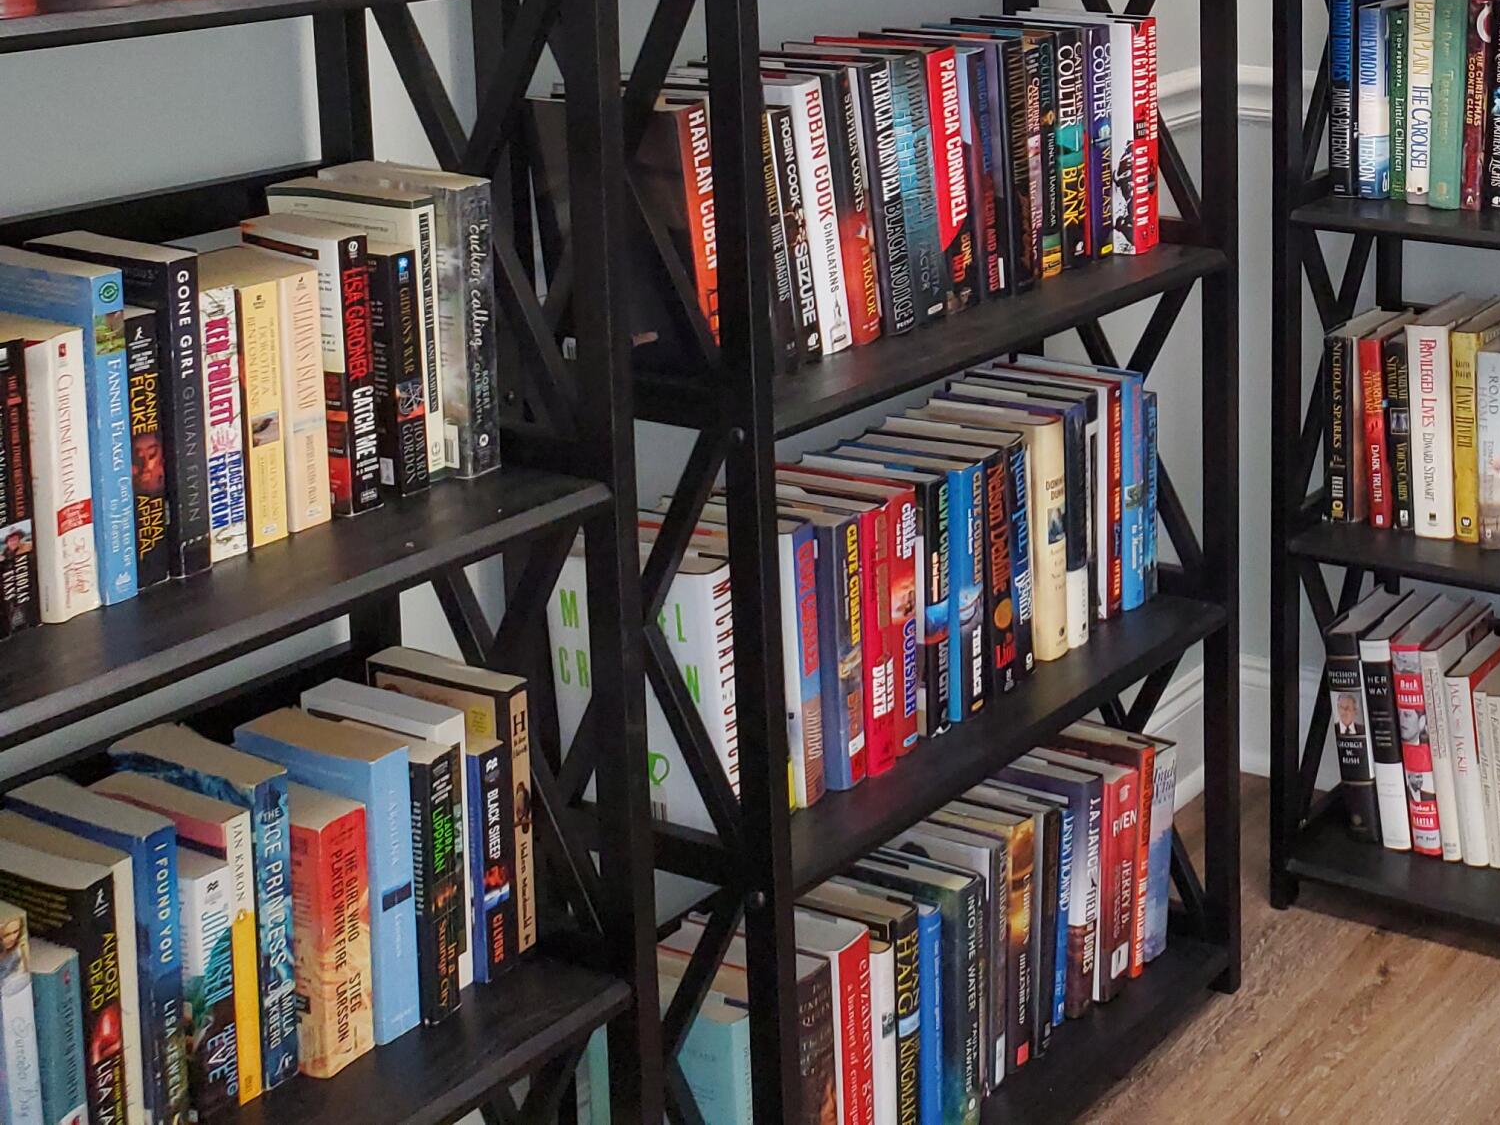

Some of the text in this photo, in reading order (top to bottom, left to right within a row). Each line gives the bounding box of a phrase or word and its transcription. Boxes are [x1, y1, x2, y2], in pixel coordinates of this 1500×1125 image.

[1058, 45, 1076, 128] COULTER
[939, 57, 968, 227] PATRICIA CORNWELL
[805, 88, 839, 294] ROBIN COOK CHARLATANS
[1063, 166, 1080, 226] BLANK
[794, 242, 817, 326] SEIZURE
[129, 376, 147, 436] FLUKE
[143, 372, 158, 432] JOANNE
[175, 268, 201, 523] GONE GIRL GILLIAN FLYNN
[136, 495, 155, 559] APPEAL
[149, 496, 165, 547] FINAL
[155, 857, 173, 963] FOUND YOU
[264, 821, 287, 968] ICE PRINCESS
[967, 965, 976, 1012] WATER
[965, 1038, 973, 1093] HAWKINS
